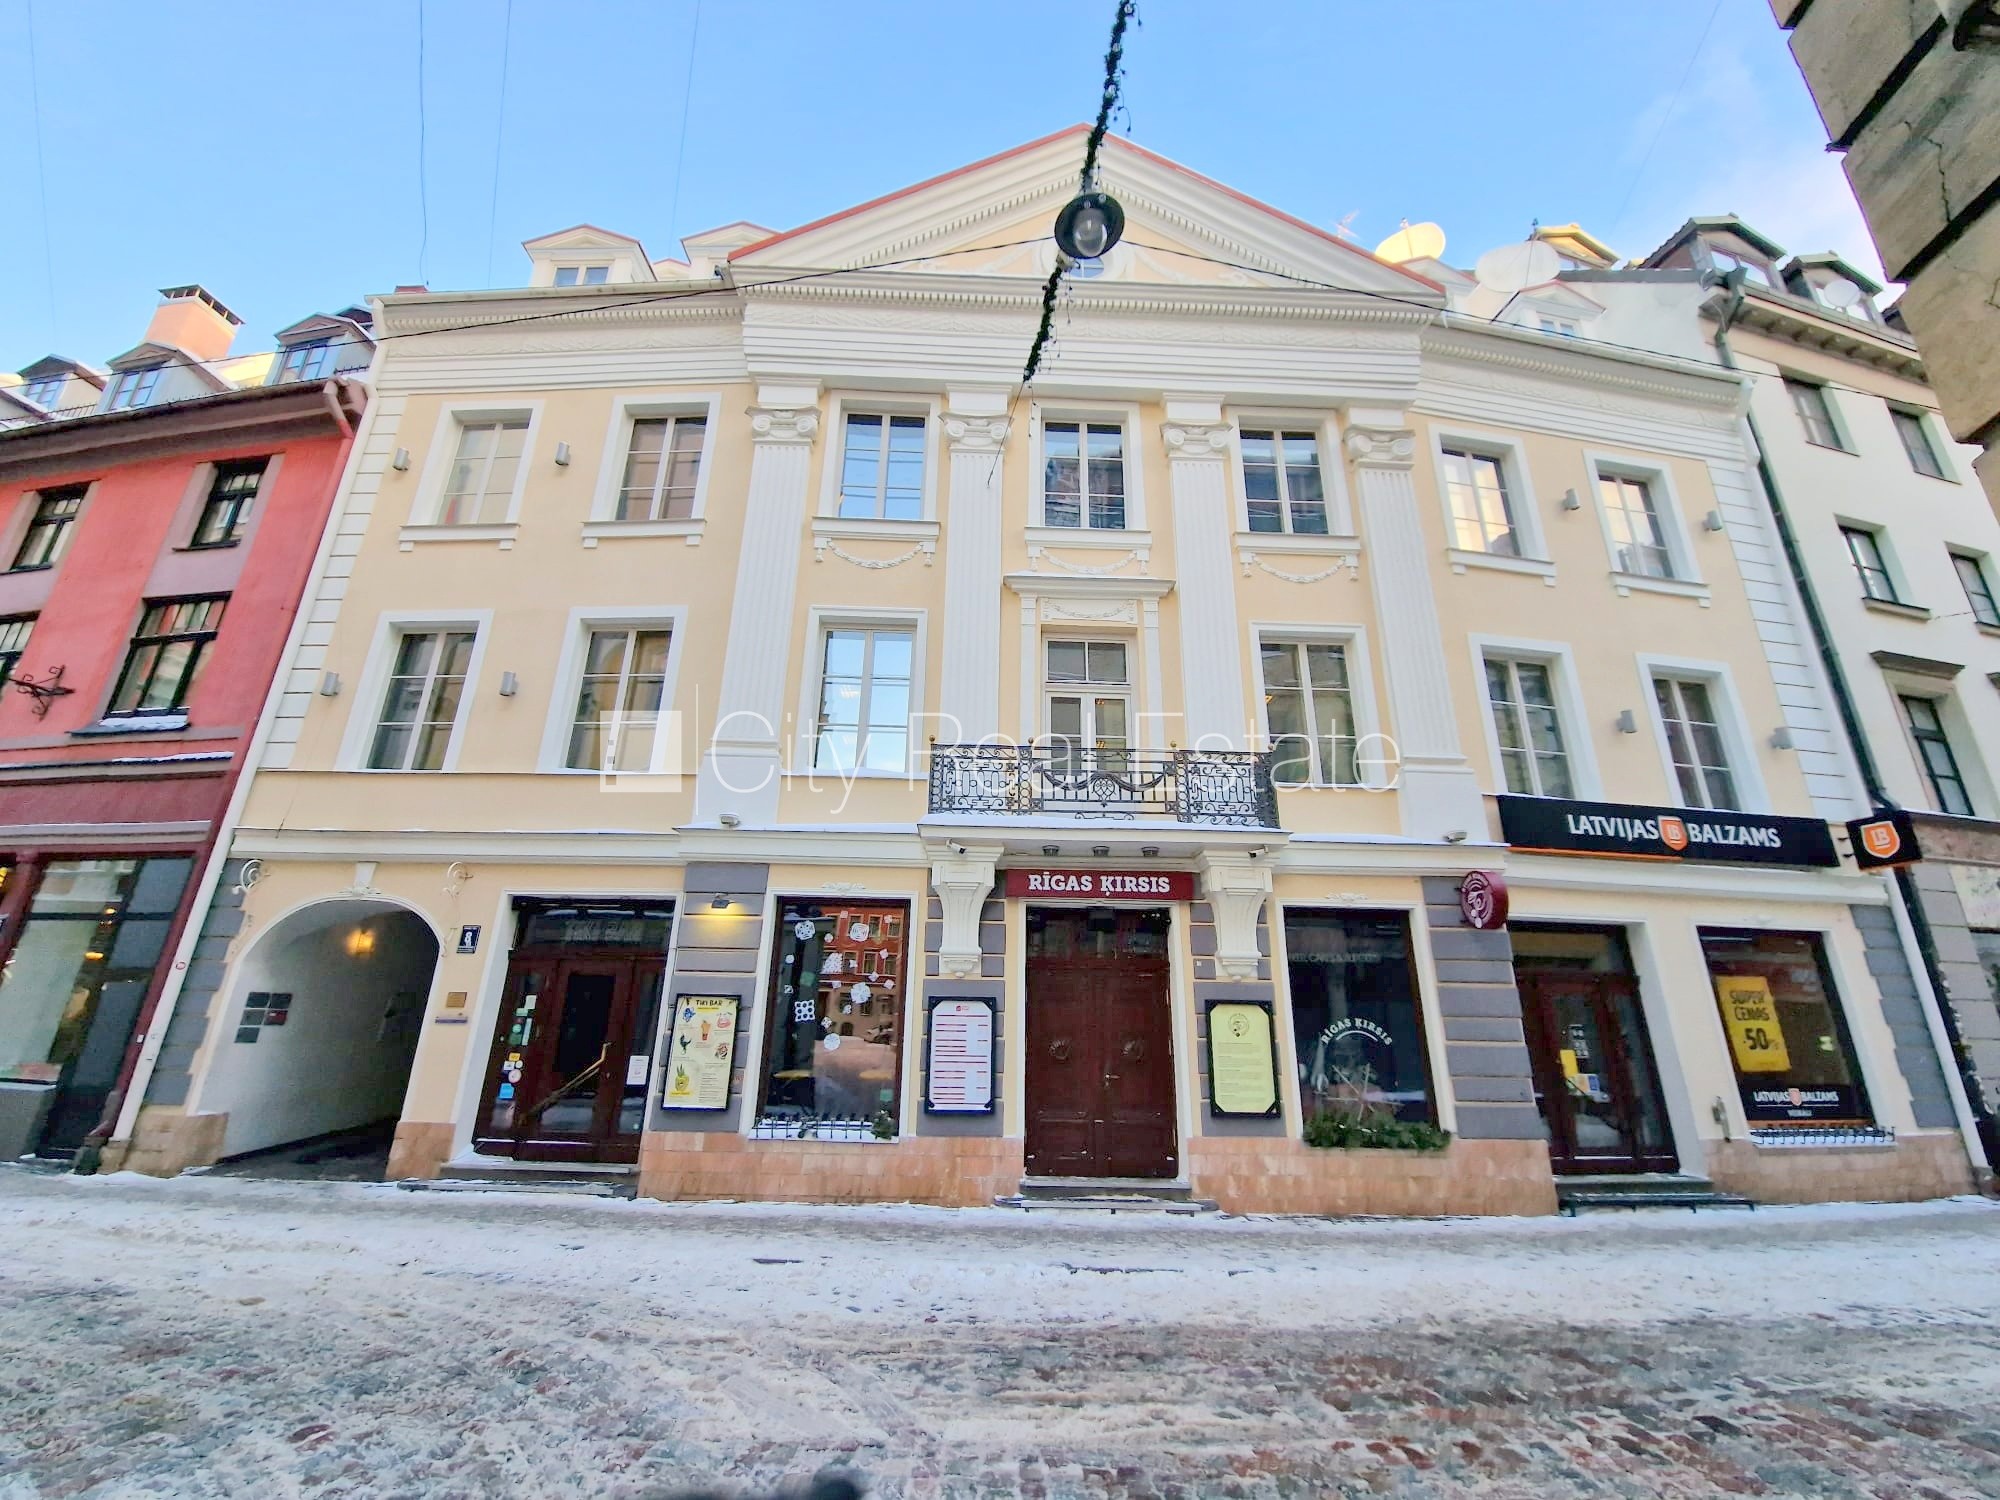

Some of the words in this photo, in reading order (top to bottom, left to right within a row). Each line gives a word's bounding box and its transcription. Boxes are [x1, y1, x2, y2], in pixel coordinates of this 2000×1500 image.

[1567, 814, 1660, 843] LATVIJAS
[1687, 822, 1783, 849] BALZAMS
[1028, 871, 1093, 892] RĪGAS
[1100, 875, 1171, 897] ĶIRSIS
